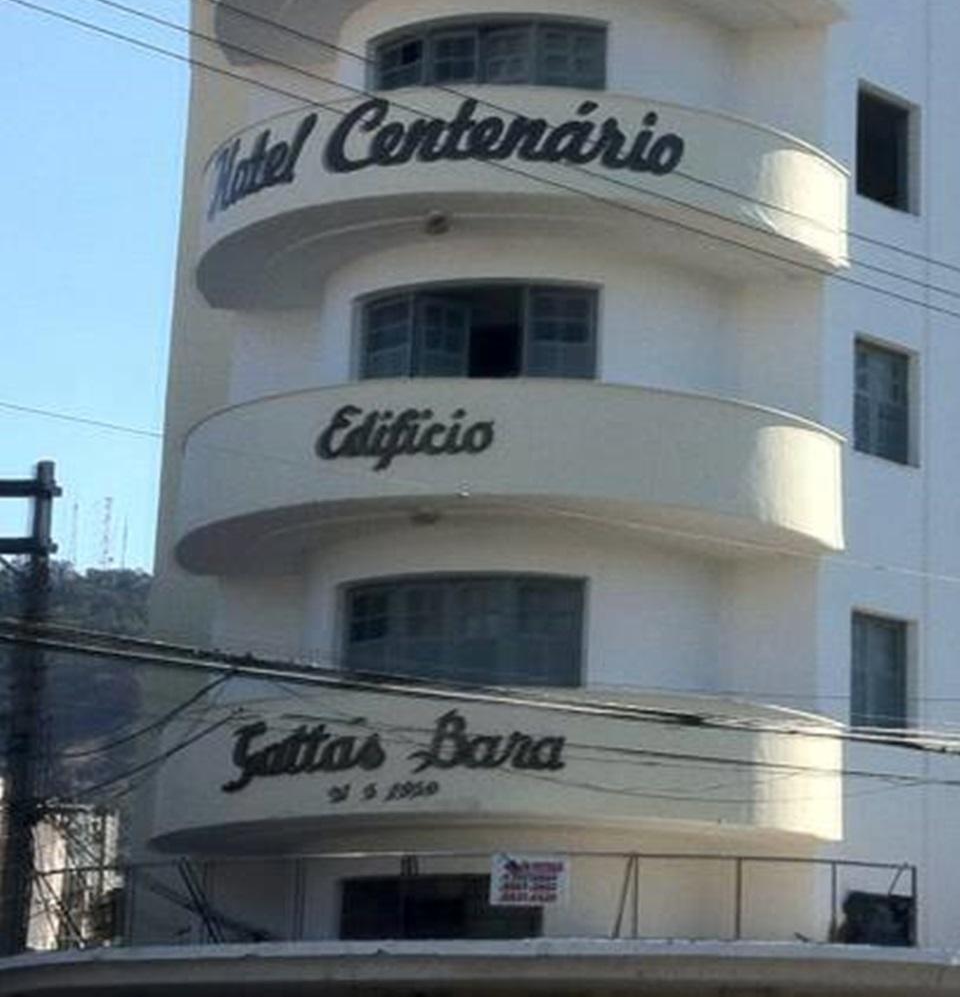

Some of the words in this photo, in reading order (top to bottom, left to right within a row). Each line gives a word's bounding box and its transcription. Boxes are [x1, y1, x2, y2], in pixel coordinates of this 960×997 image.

[207, 112, 318, 222] Hotel
[322, 97, 686, 177] Centenário
[407, 709, 566, 773] Bara
